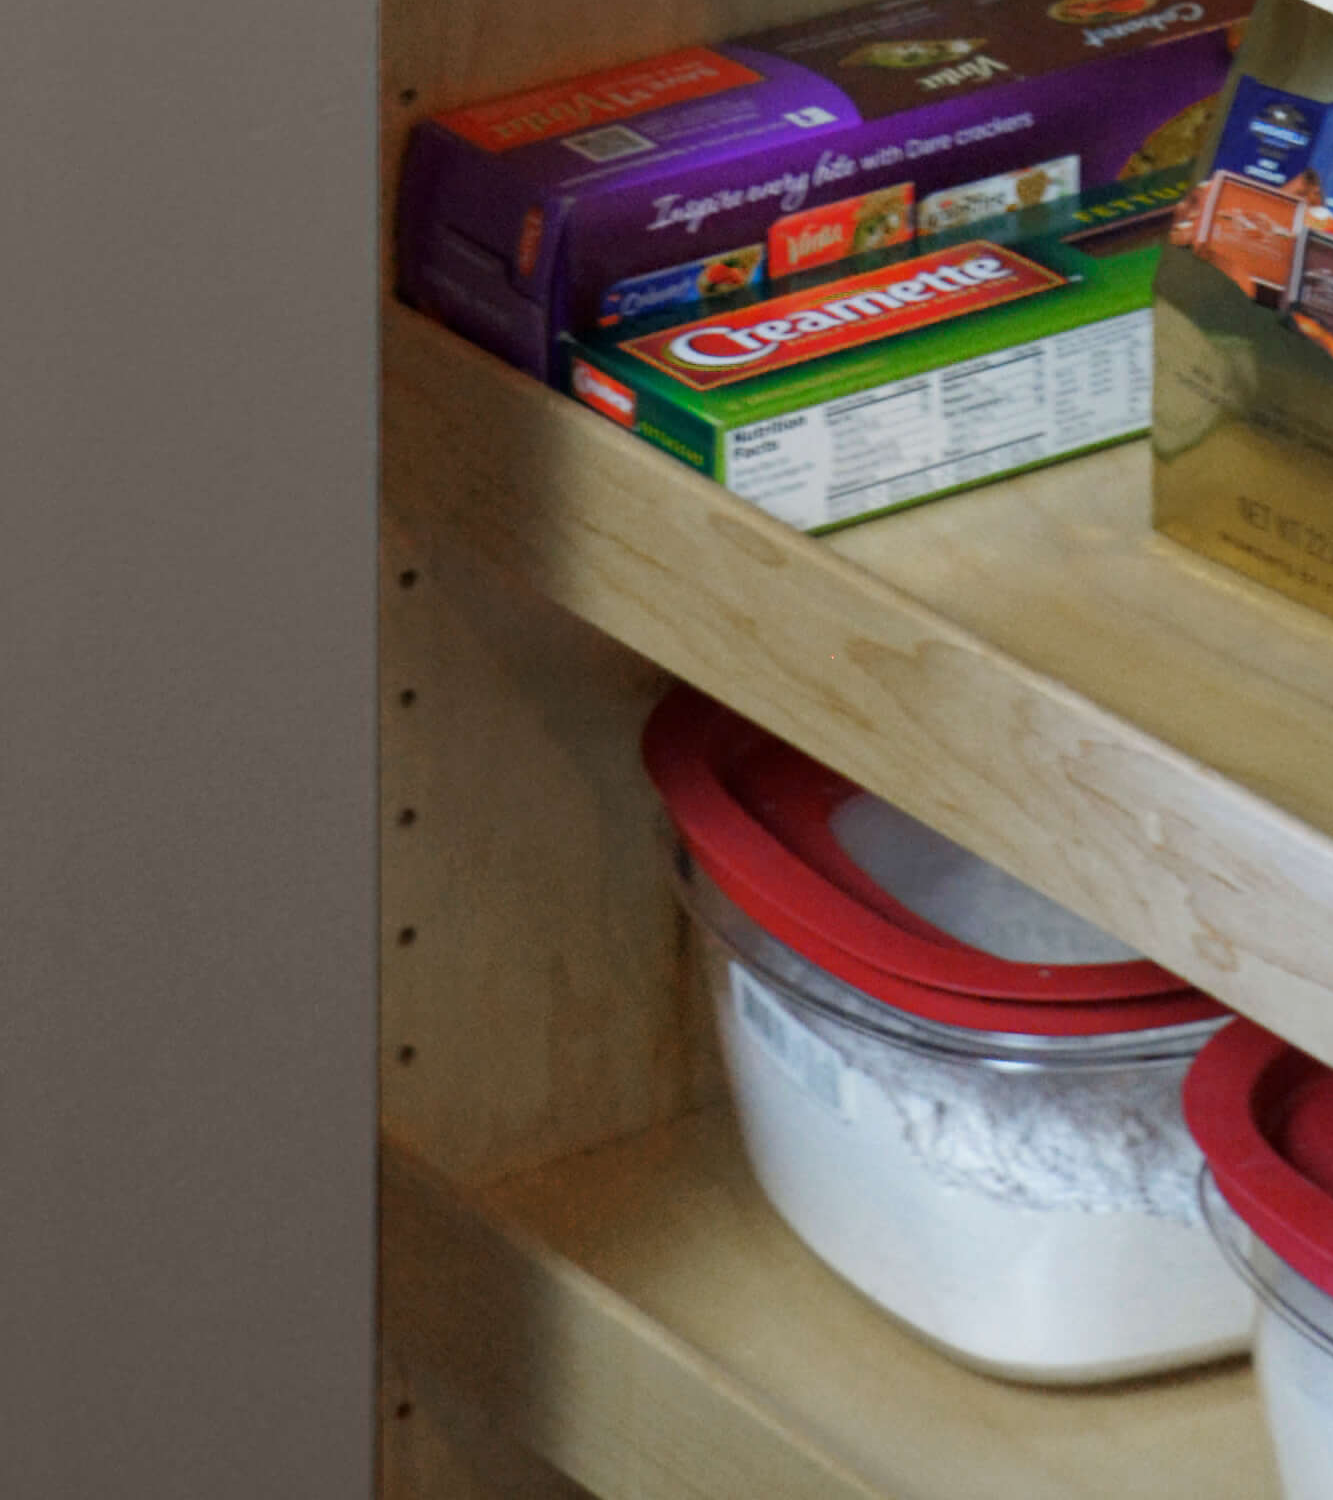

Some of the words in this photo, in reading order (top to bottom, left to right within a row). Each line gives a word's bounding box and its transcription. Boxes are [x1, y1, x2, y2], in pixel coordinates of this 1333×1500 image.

[646, 193, 743, 235] Inspire
[746, 171, 812, 213] every
[810, 148, 858, 188] bite
[858, 145, 905, 171] with
[904, 135, 953, 160] Dare
[953, 111, 1036, 146] crackers
[666, 253, 1016, 367] Creamette
